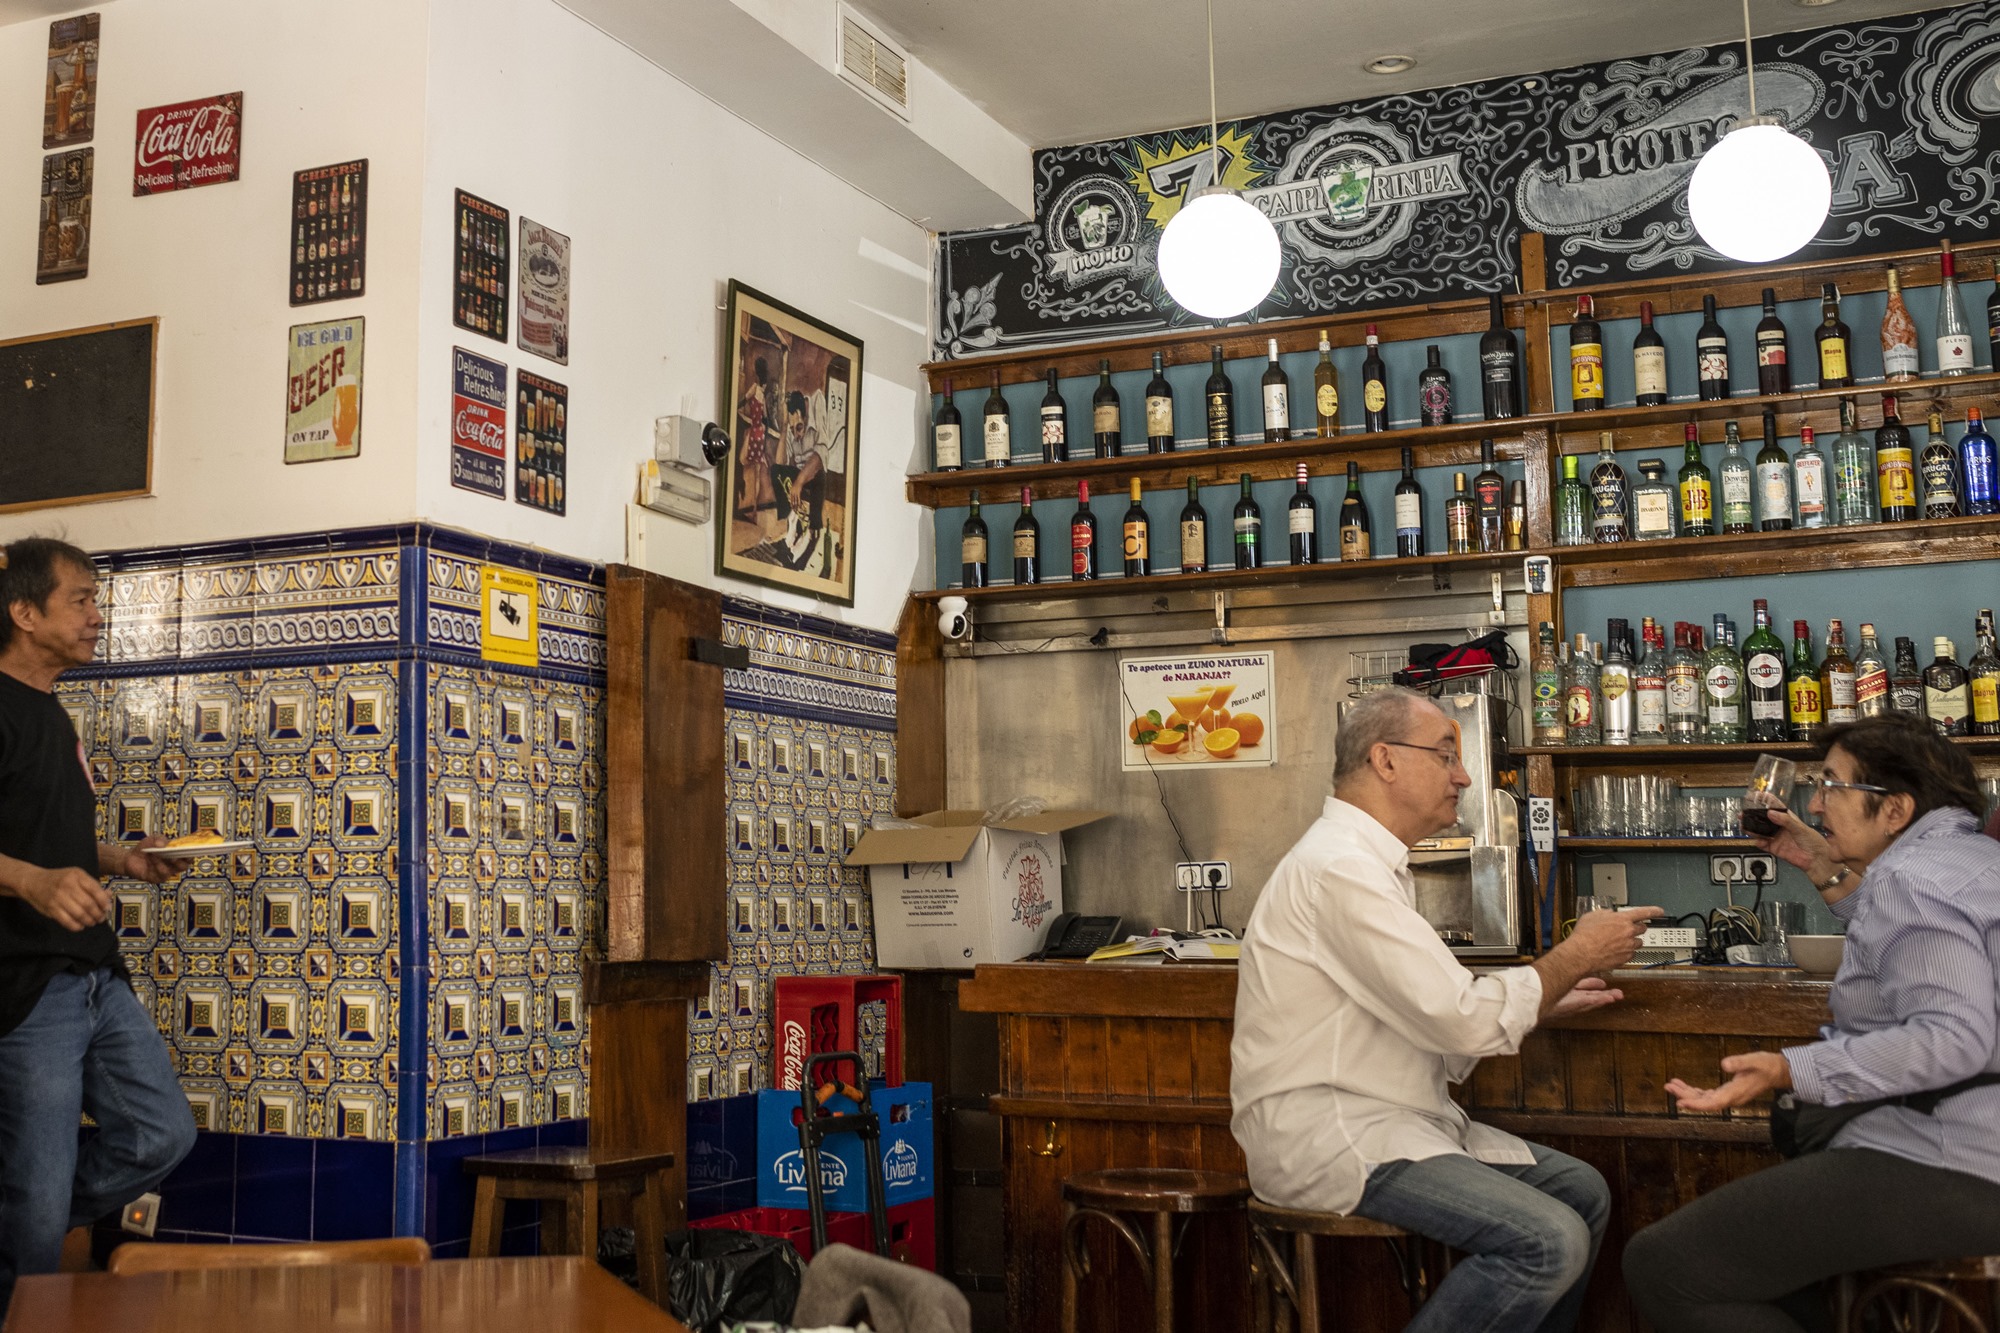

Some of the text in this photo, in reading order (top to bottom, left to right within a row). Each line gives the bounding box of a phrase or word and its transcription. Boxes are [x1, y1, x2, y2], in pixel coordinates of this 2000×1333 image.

[166, 108, 194, 121] DRINK
[138, 173, 174, 187] Delicious
[299, 162, 363, 183] CHEERS!
[459, 194, 507, 222] CHEERS!
[1071, 244, 1131, 275] mojito
[456, 353, 495, 384] Delicious
[290, 346, 345, 414] BEER
[519, 372, 567, 398] CHEERS!
[467, 404, 489, 419] DRINK
[292, 429, 330, 444] ON TAP
[1797, 459, 1821, 468] BEEFEATER
[1127, 657, 1265, 674] Te apetece un ZUMO NATURAL
[1749, 667, 1780, 675] MARTINI
[1162, 671, 1232, 682] de NARANJA??
[1708, 678, 1737, 686] MARTINI
[778, 1160, 845, 1188] Livna
